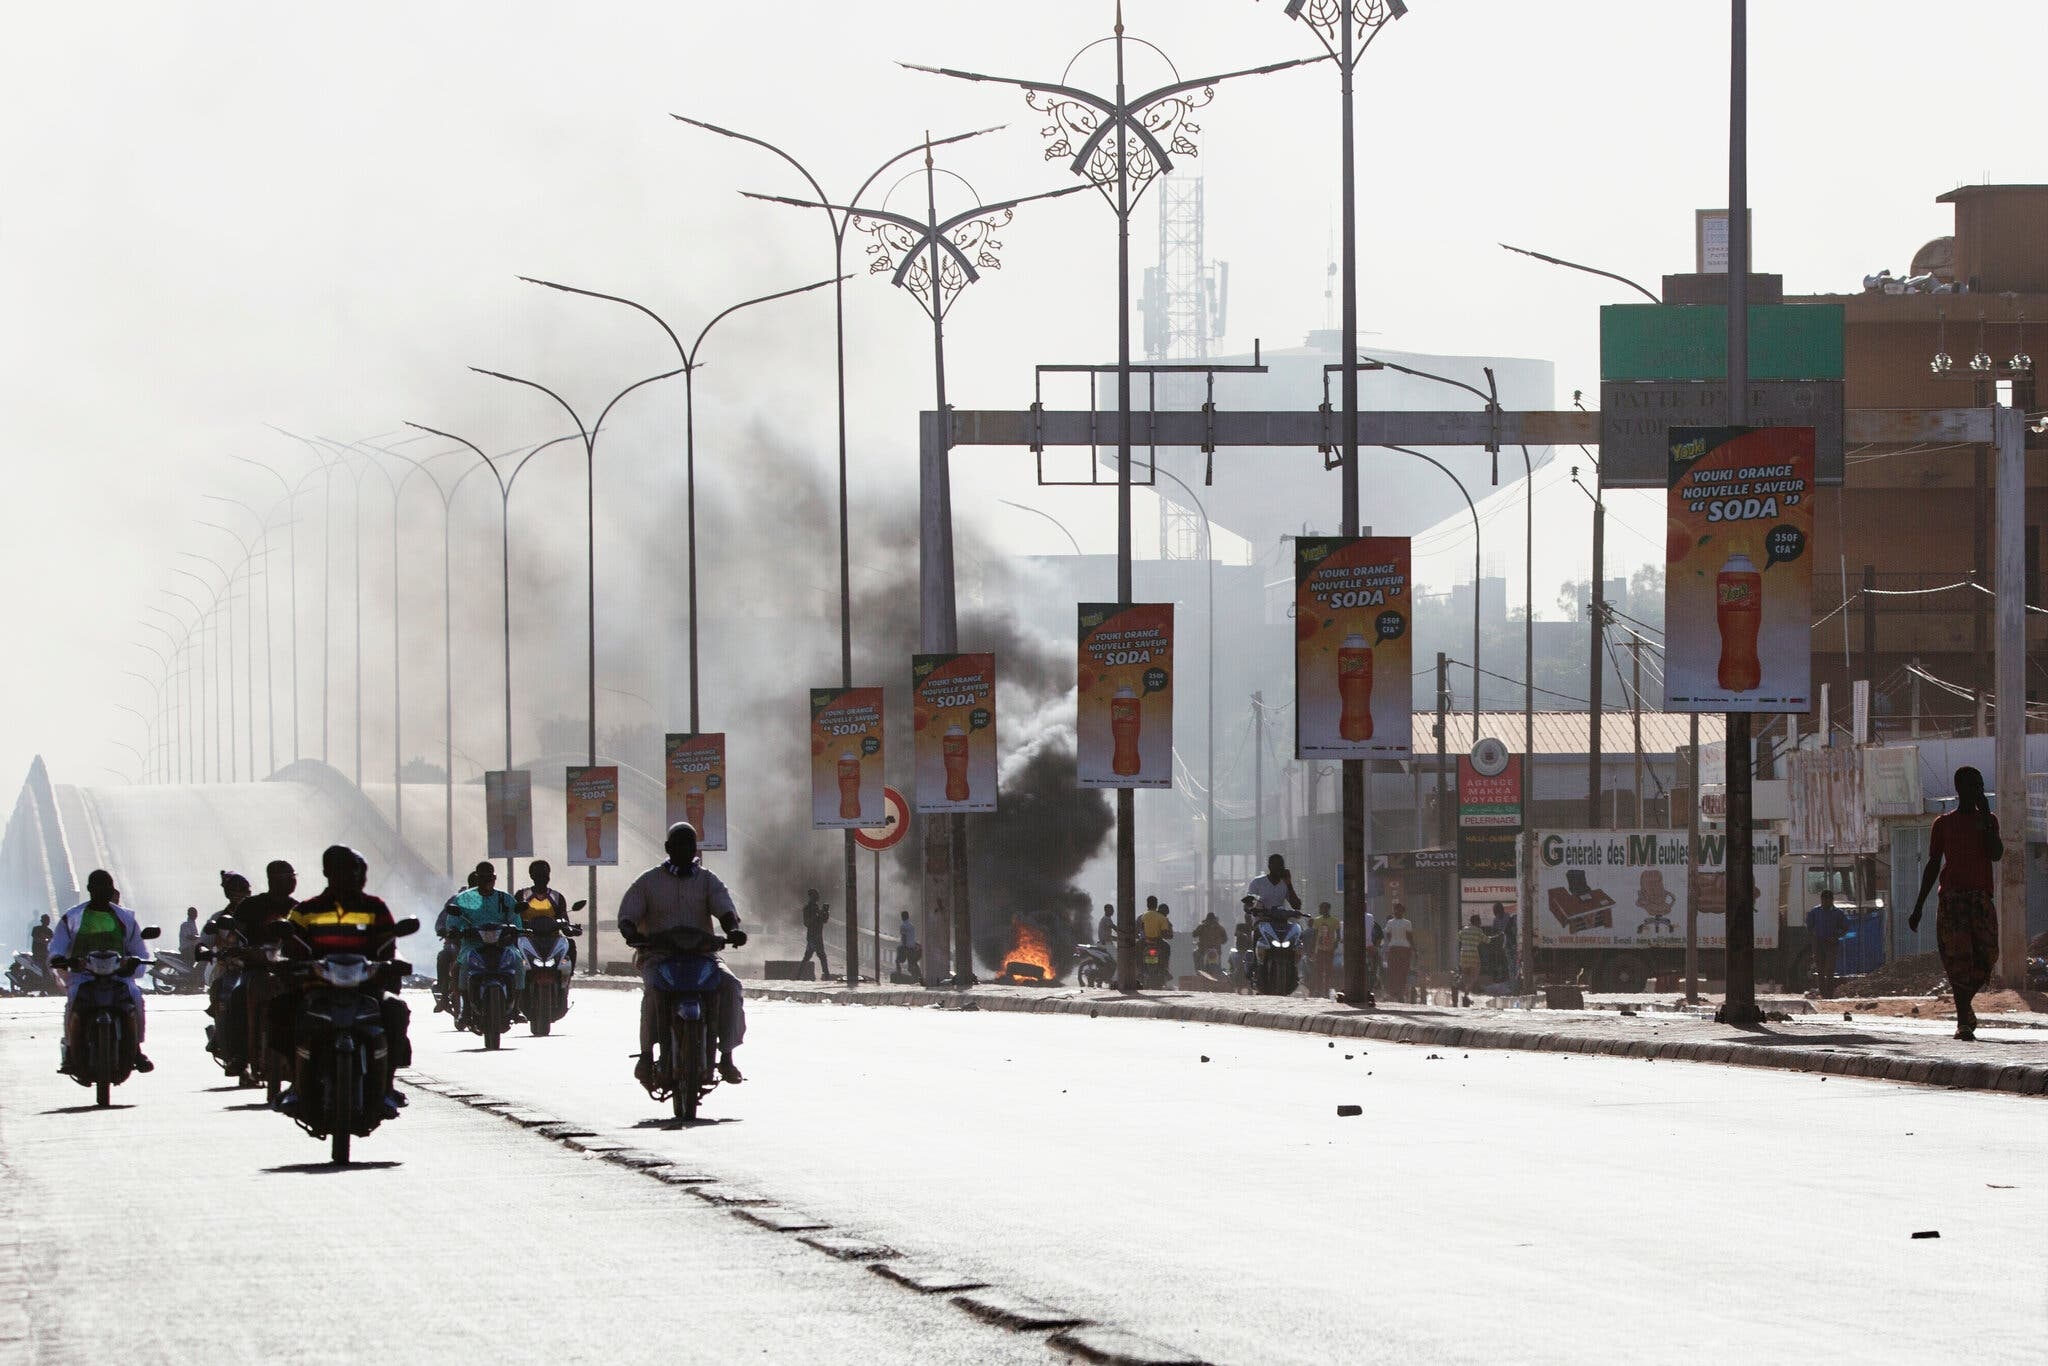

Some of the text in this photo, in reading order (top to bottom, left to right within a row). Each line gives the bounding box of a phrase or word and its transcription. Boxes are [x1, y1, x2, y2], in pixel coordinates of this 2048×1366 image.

[1671, 437, 1706, 461] Youki
[1693, 466, 1792, 482] YOUKI ORANGE
[1683, 480, 1804, 499] NOUVELLE SAVEUR
[1775, 533, 1798, 542] 350F
[1318, 564, 1395, 578] YOUKI ORANGE
[1311, 576, 1405, 591] NOUVELLE SAVEUR
[1096, 629, 1160, 640] YOUKI ORANGE
[1088, 638, 1168, 651] NOUVELLE SAVEUR
[1415, 852, 1456, 860] Oran
[1541, 834, 1601, 866] Générale
[1607, 839, 1624, 866] des
[1627, 834, 1688, 866] Meubles
[1464, 885, 1516, 893] BILLETTERI
